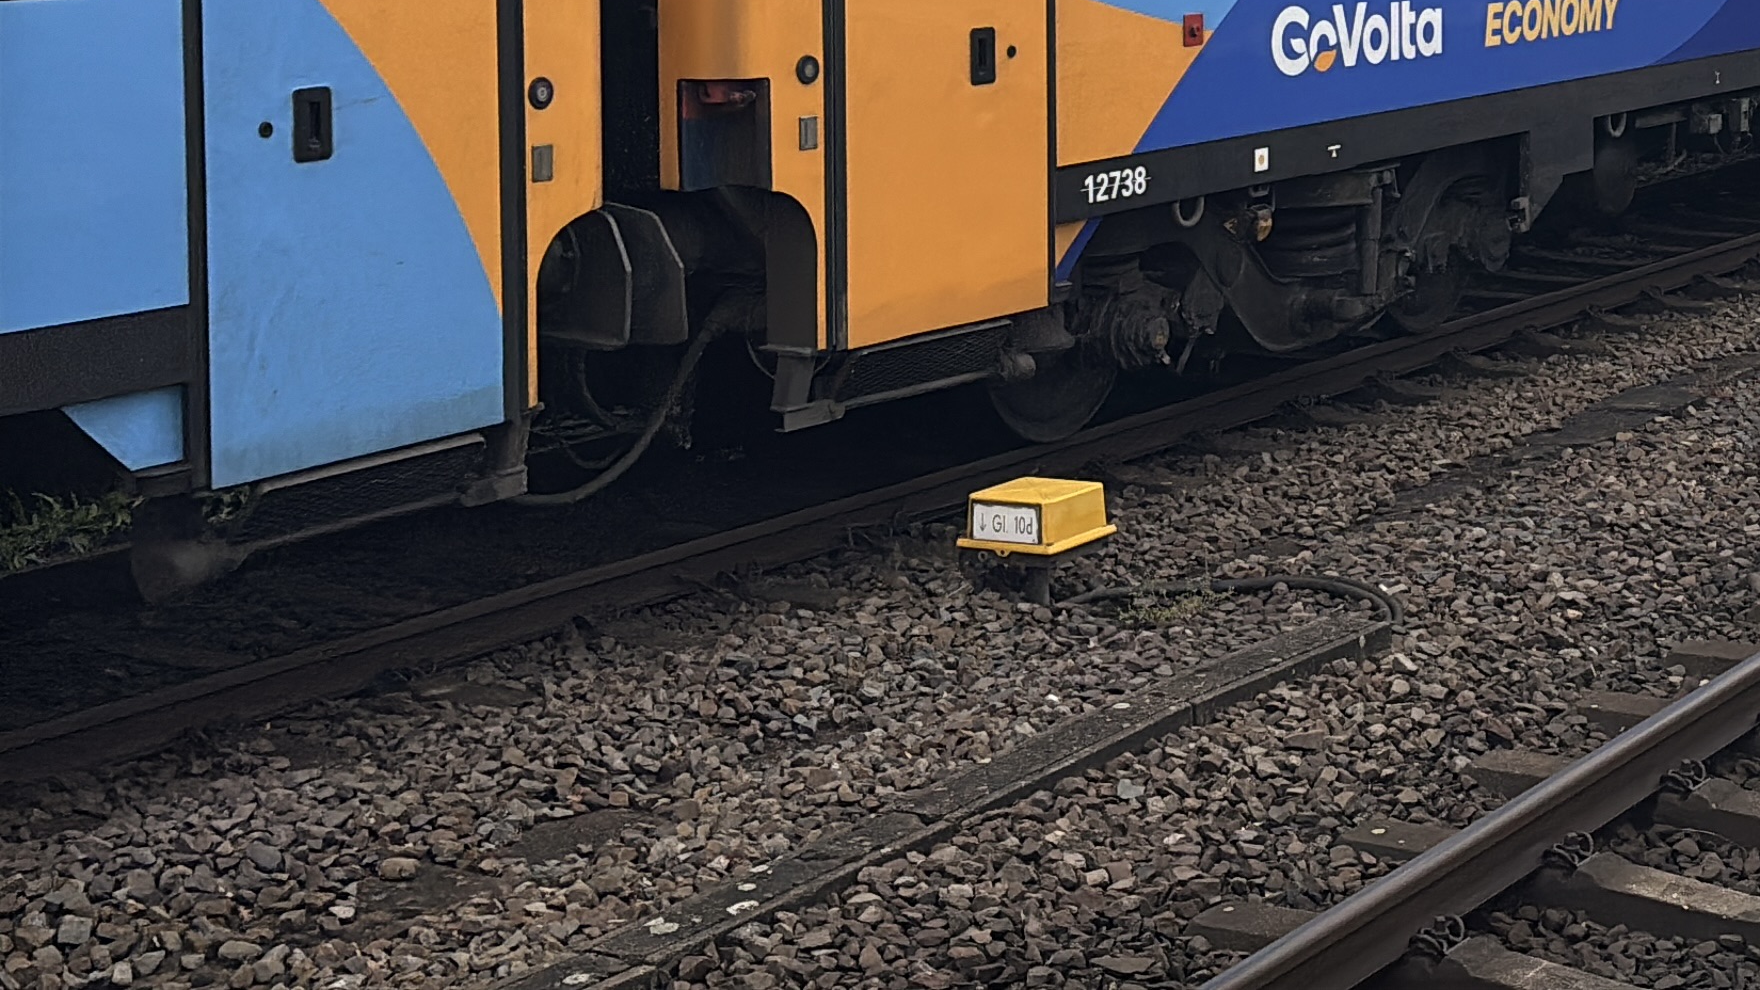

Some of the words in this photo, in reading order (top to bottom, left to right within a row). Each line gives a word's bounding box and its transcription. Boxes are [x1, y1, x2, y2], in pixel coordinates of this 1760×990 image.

[1271, 0, 1443, 77] GoVolta
[1083, 165, 1148, 204] 12738
[1014, 515, 1033, 536] 10d
